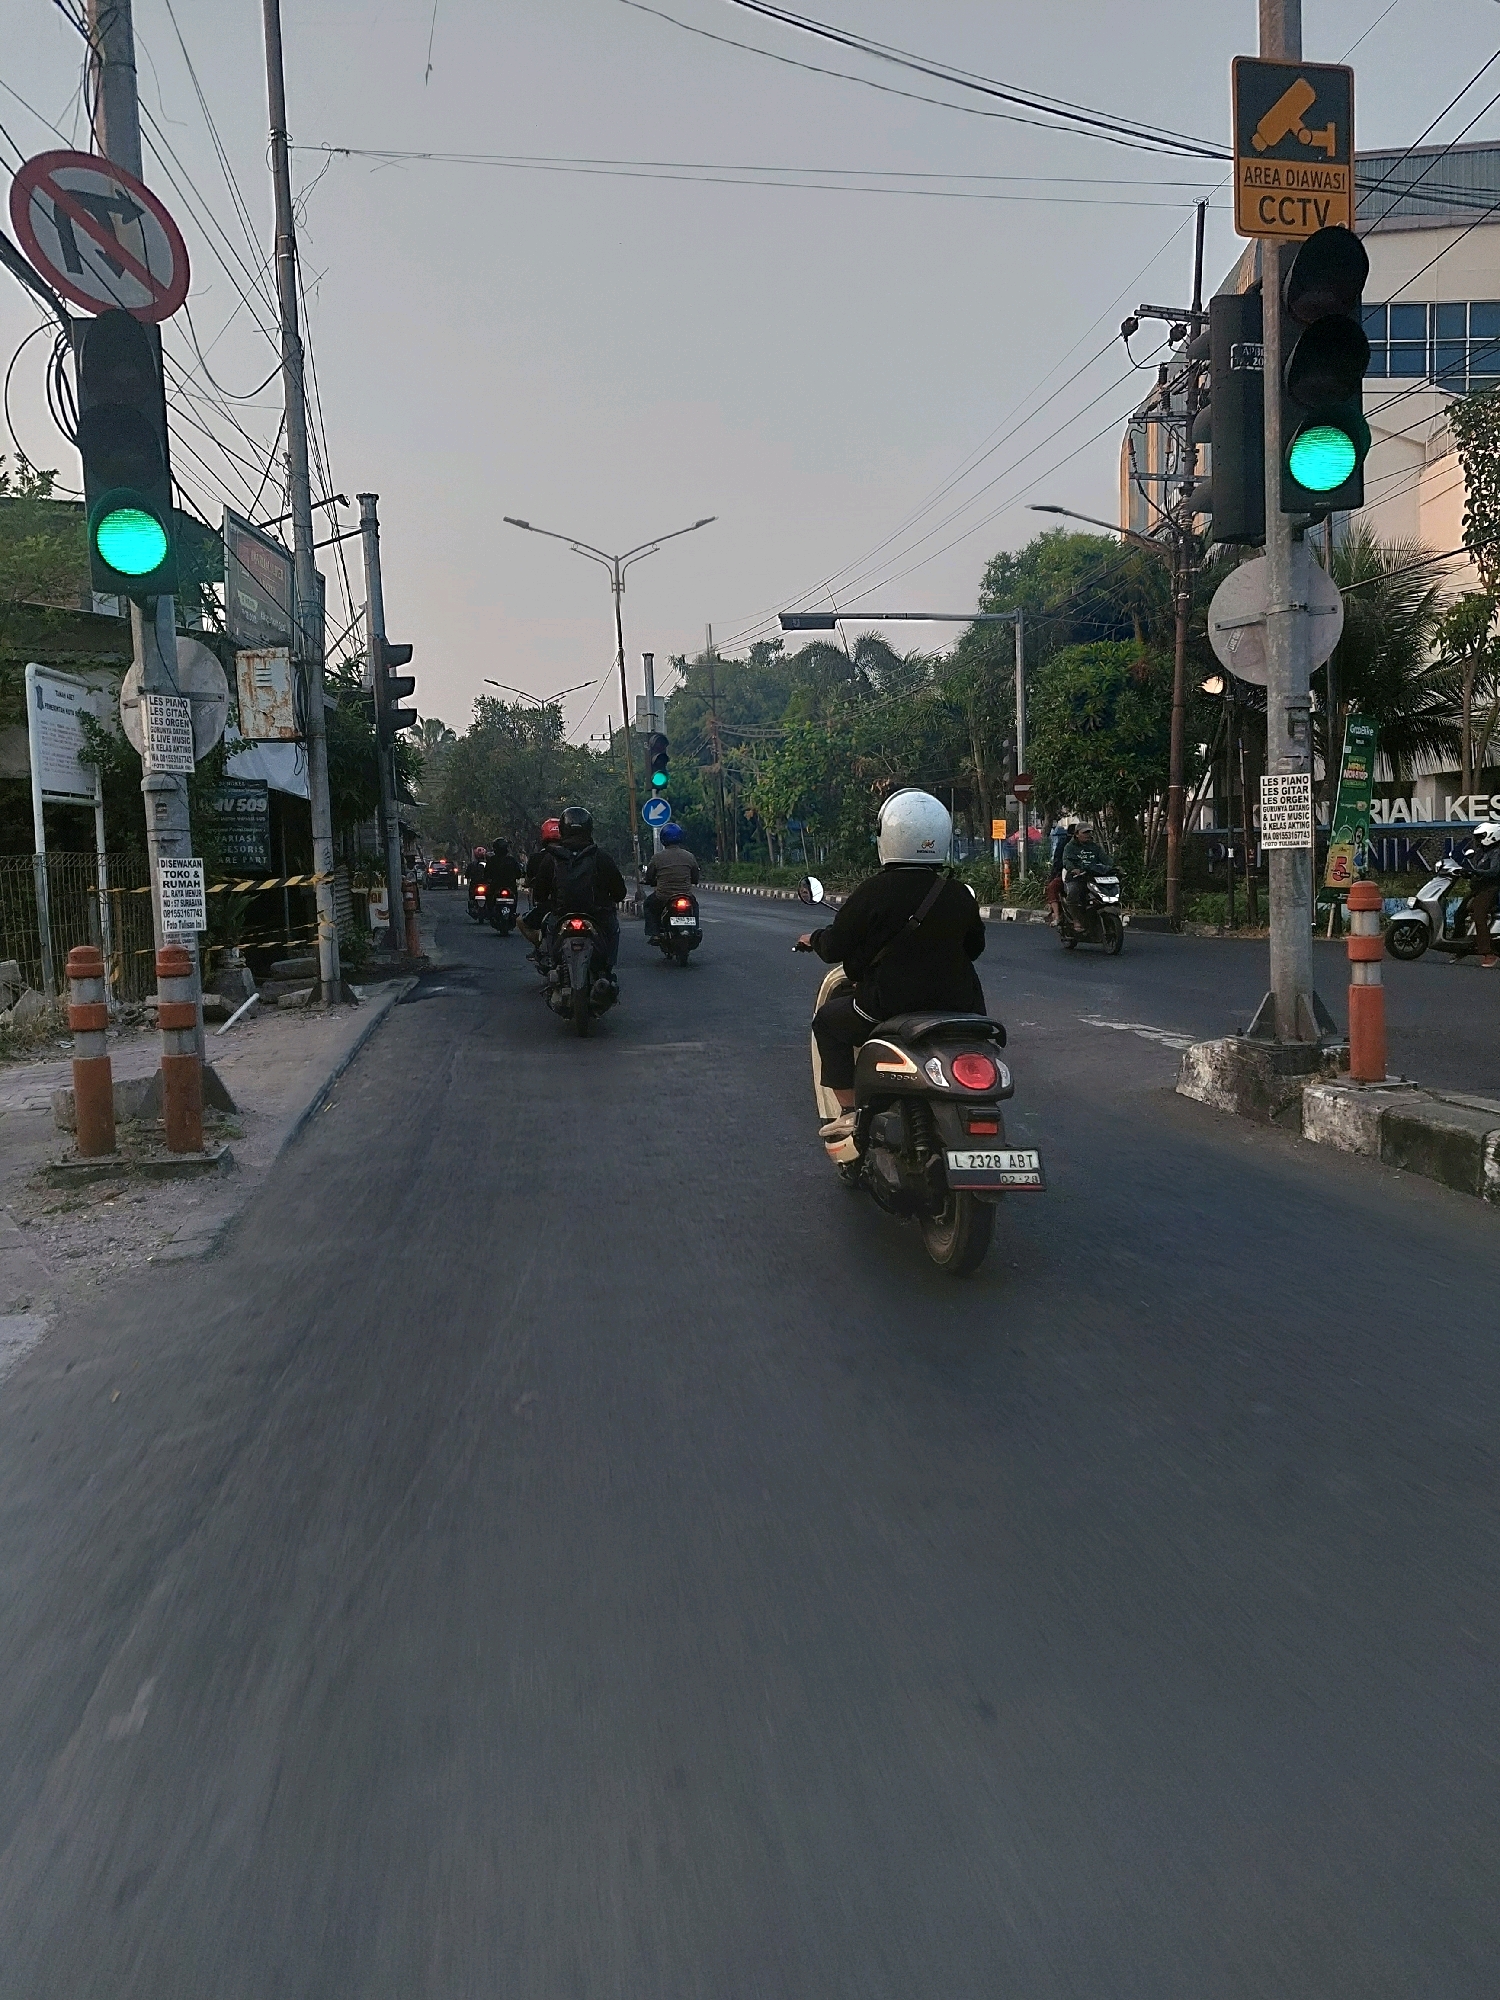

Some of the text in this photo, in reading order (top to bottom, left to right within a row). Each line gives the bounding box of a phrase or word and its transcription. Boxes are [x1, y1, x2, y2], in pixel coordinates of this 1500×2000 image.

[1244, 166, 1345, 190] AREA DIAWASI
[1259, 195, 1331, 228] CCTV
[149, 696, 188, 708] LES PIANO
[149, 706, 188, 718] LES GITAR
[150, 716, 190, 728] LES ORGEN
[151, 734, 191, 745] & LIVE MUSIC
[155, 744, 172, 752] KELAS
[1262, 775, 1309, 787] LES PIANO
[1262, 785, 1309, 796] LES GITAR
[235, 798, 268, 812] 509
[1262, 795, 1309, 805] LES ORGEN
[1263, 805, 1287, 813] GURUNYA
[1263, 812, 1310, 821] & LIVE MUSIC
[1269, 822, 1287, 830] KELAS
[1287, 821, 1310, 830] AKTING
[1263, 832, 1272, 841] WA
[160, 859, 202, 869] DISEWAKAN
[163, 870, 190, 879] TOKO
[162, 880, 200, 888] RUMAH
[162, 889, 202, 898] JL. RAYA MENUR
[180, 899, 203, 907] SURABAYA
[163, 909, 203, 918] 081553167743
[954, 1154, 1033, 1169] L 2328 ABT
